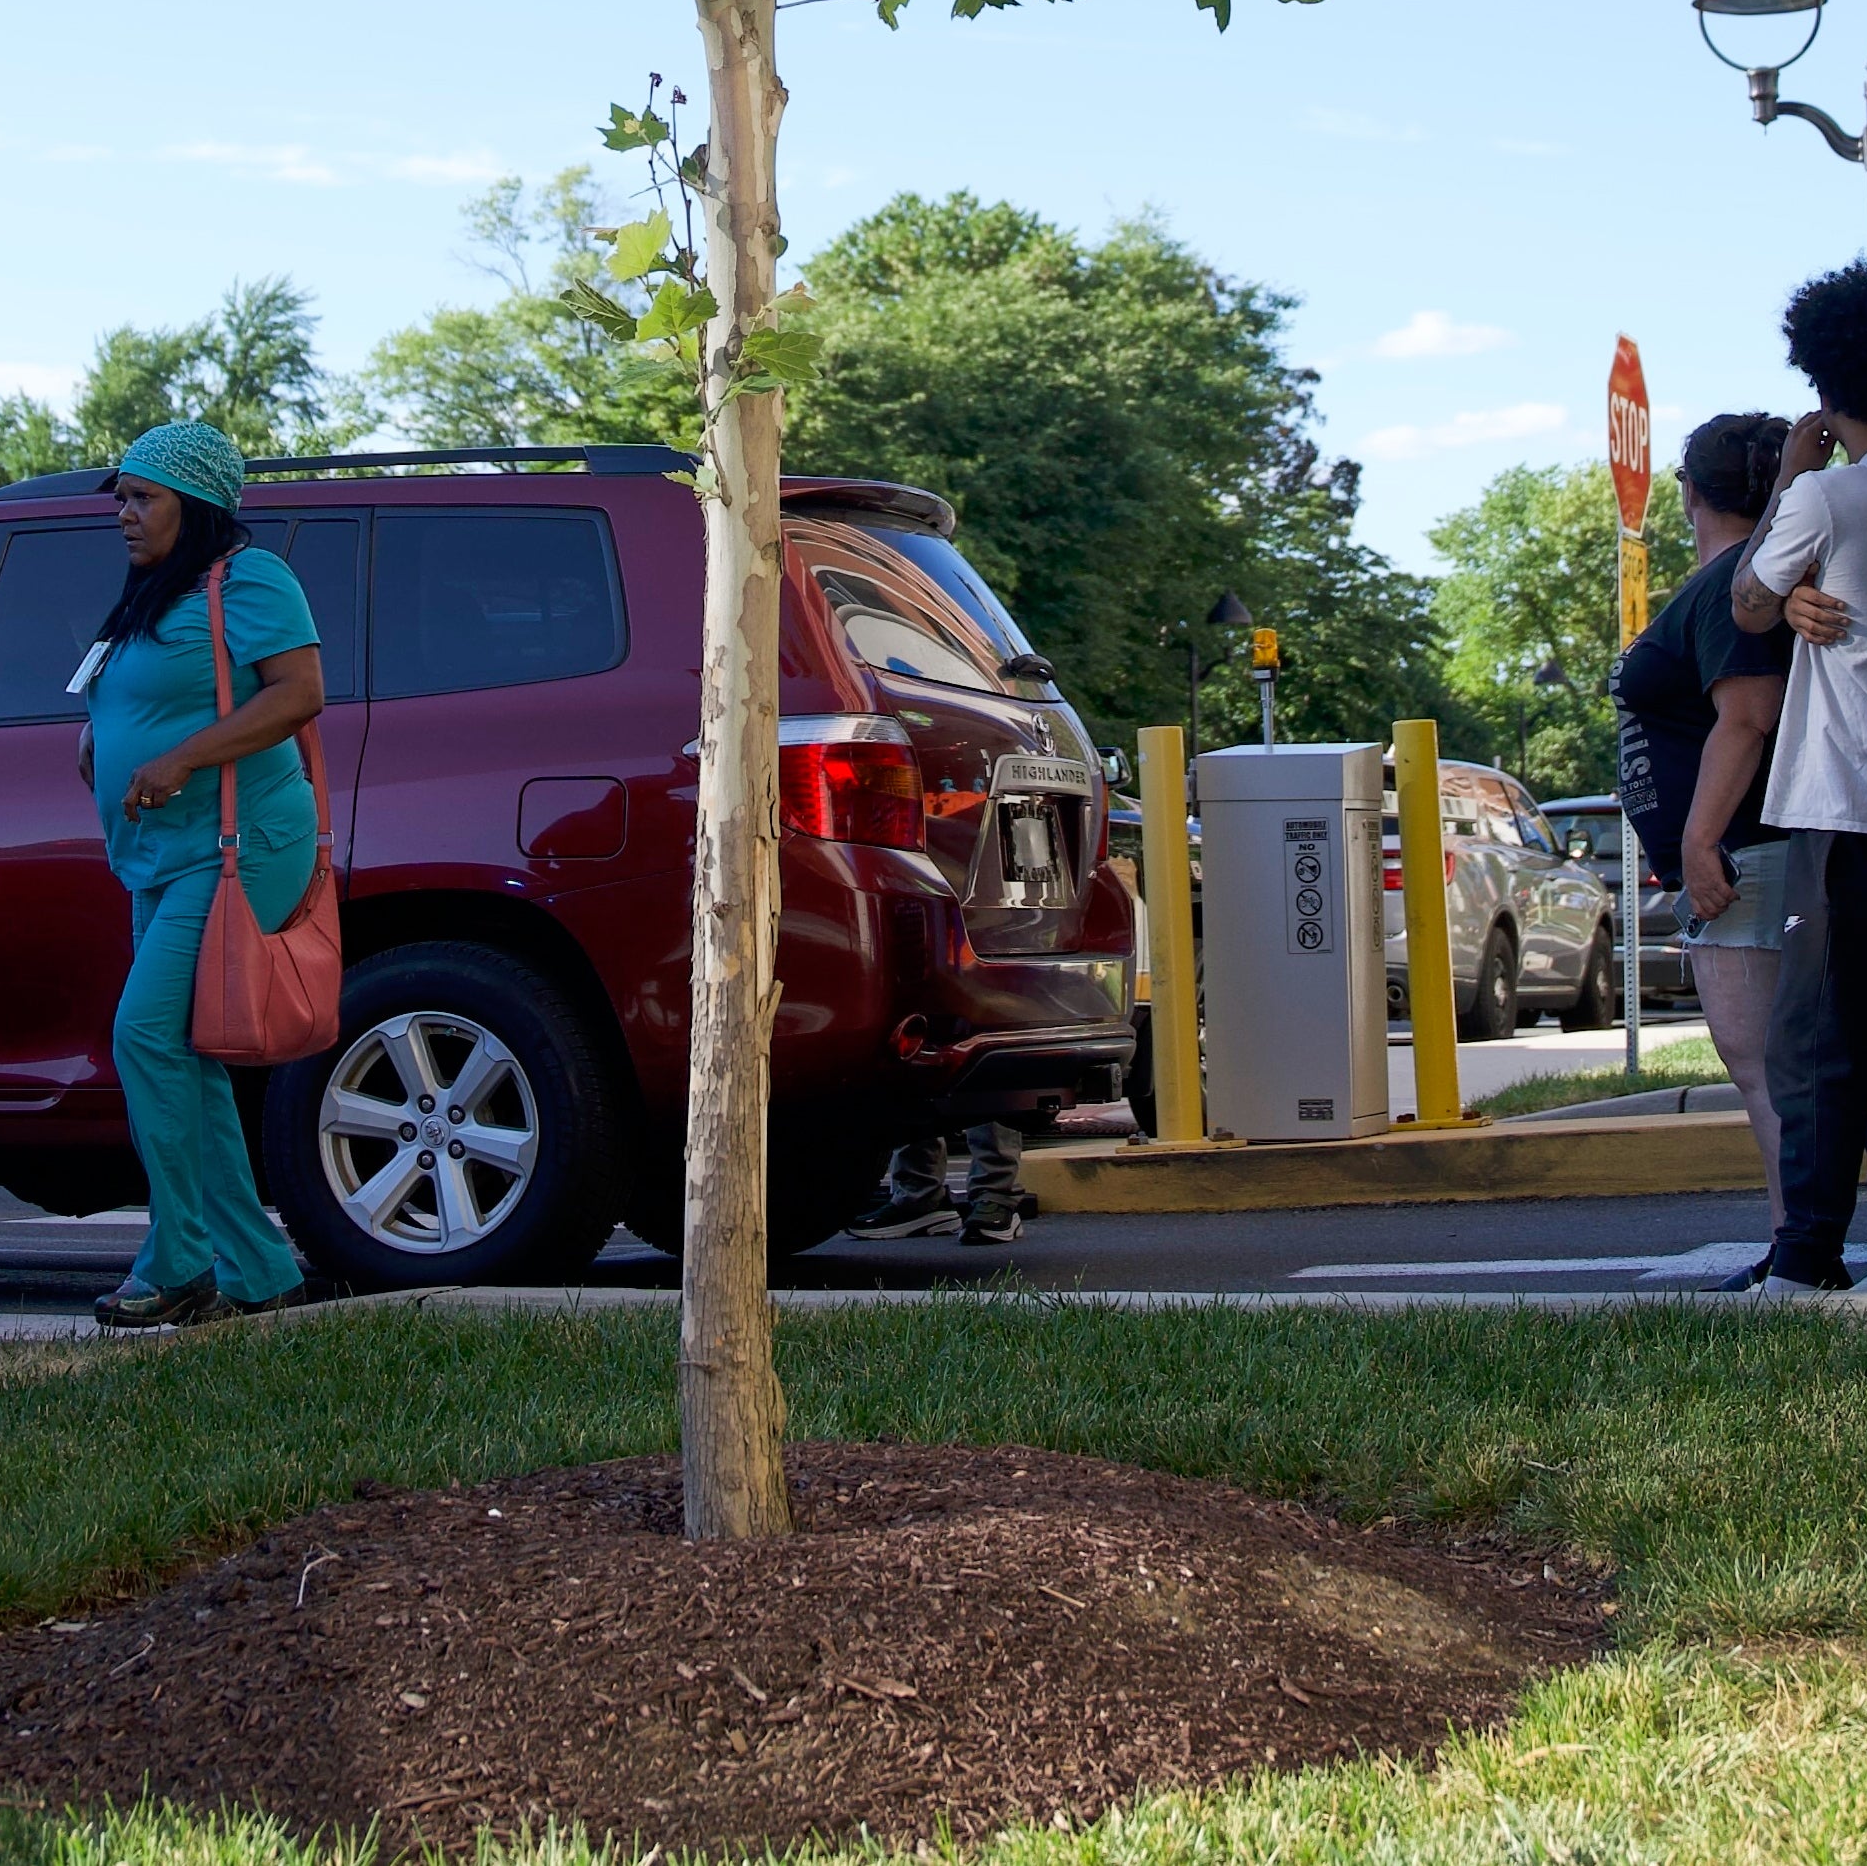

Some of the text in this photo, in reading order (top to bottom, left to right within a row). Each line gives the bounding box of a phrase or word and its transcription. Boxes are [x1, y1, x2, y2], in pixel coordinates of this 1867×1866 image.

[1610, 392, 1648, 474] STOP
[1011, 764, 1087, 785] HIGHLANDER
[1298, 843, 1316, 851] NO
